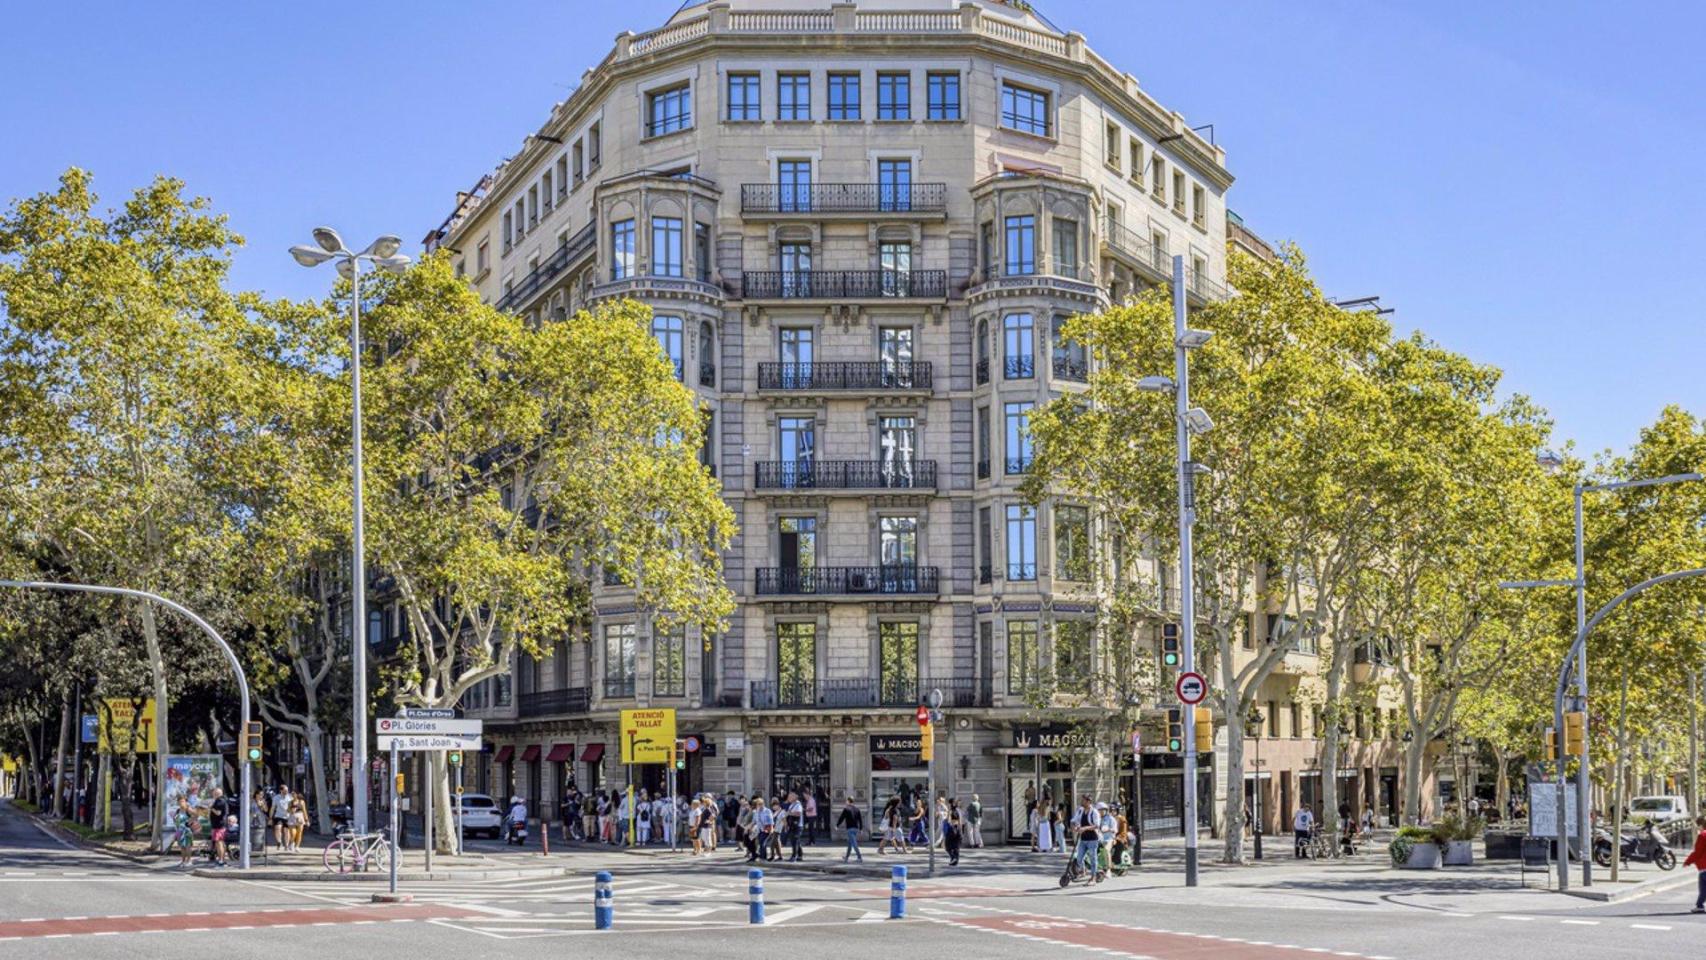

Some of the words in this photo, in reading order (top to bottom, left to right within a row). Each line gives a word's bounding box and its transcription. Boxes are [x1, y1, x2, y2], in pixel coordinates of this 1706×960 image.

[633, 711, 664, 719] ATENCIÓ
[391, 722, 402, 730] Pl.
[409, 738, 428, 747] Sant
[430, 738, 451, 747] Joan
[888, 741, 922, 749] MACSO
[173, 762, 214, 771] mayoral
